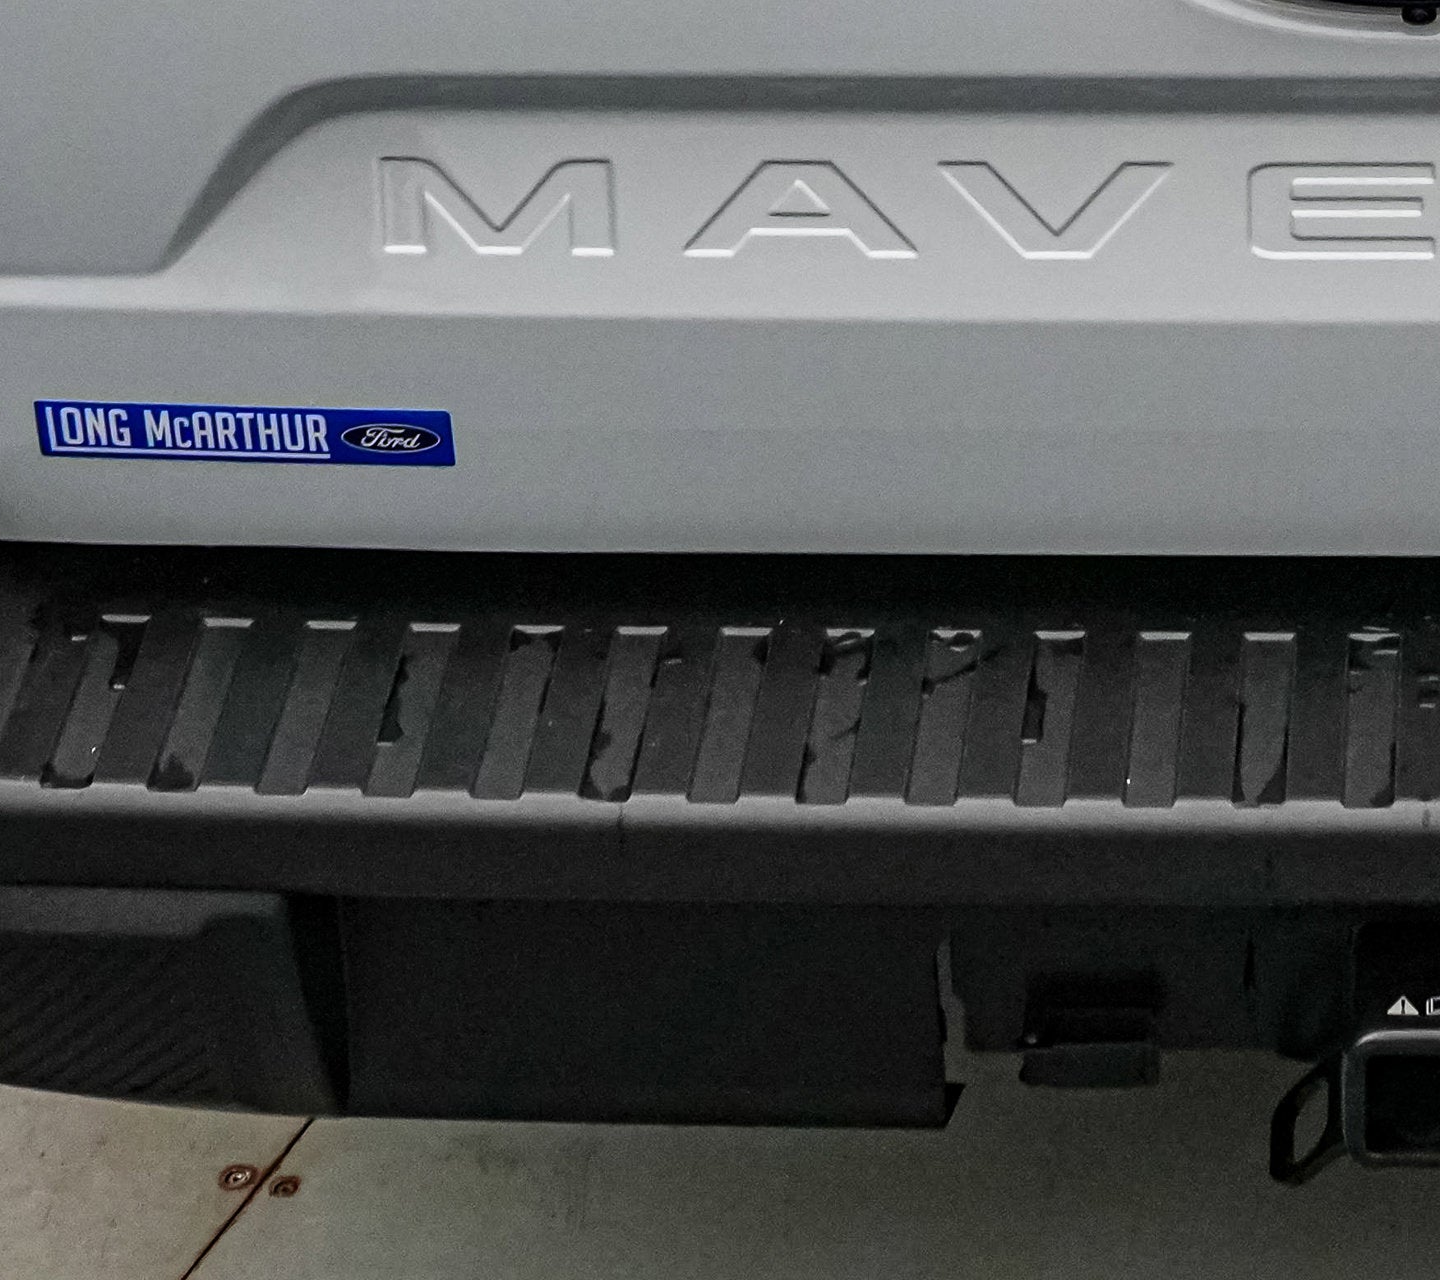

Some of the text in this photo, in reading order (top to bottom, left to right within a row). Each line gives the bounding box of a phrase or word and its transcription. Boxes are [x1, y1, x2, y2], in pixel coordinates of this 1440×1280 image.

[46, 406, 421, 452] LONG McARTHUR Ford
